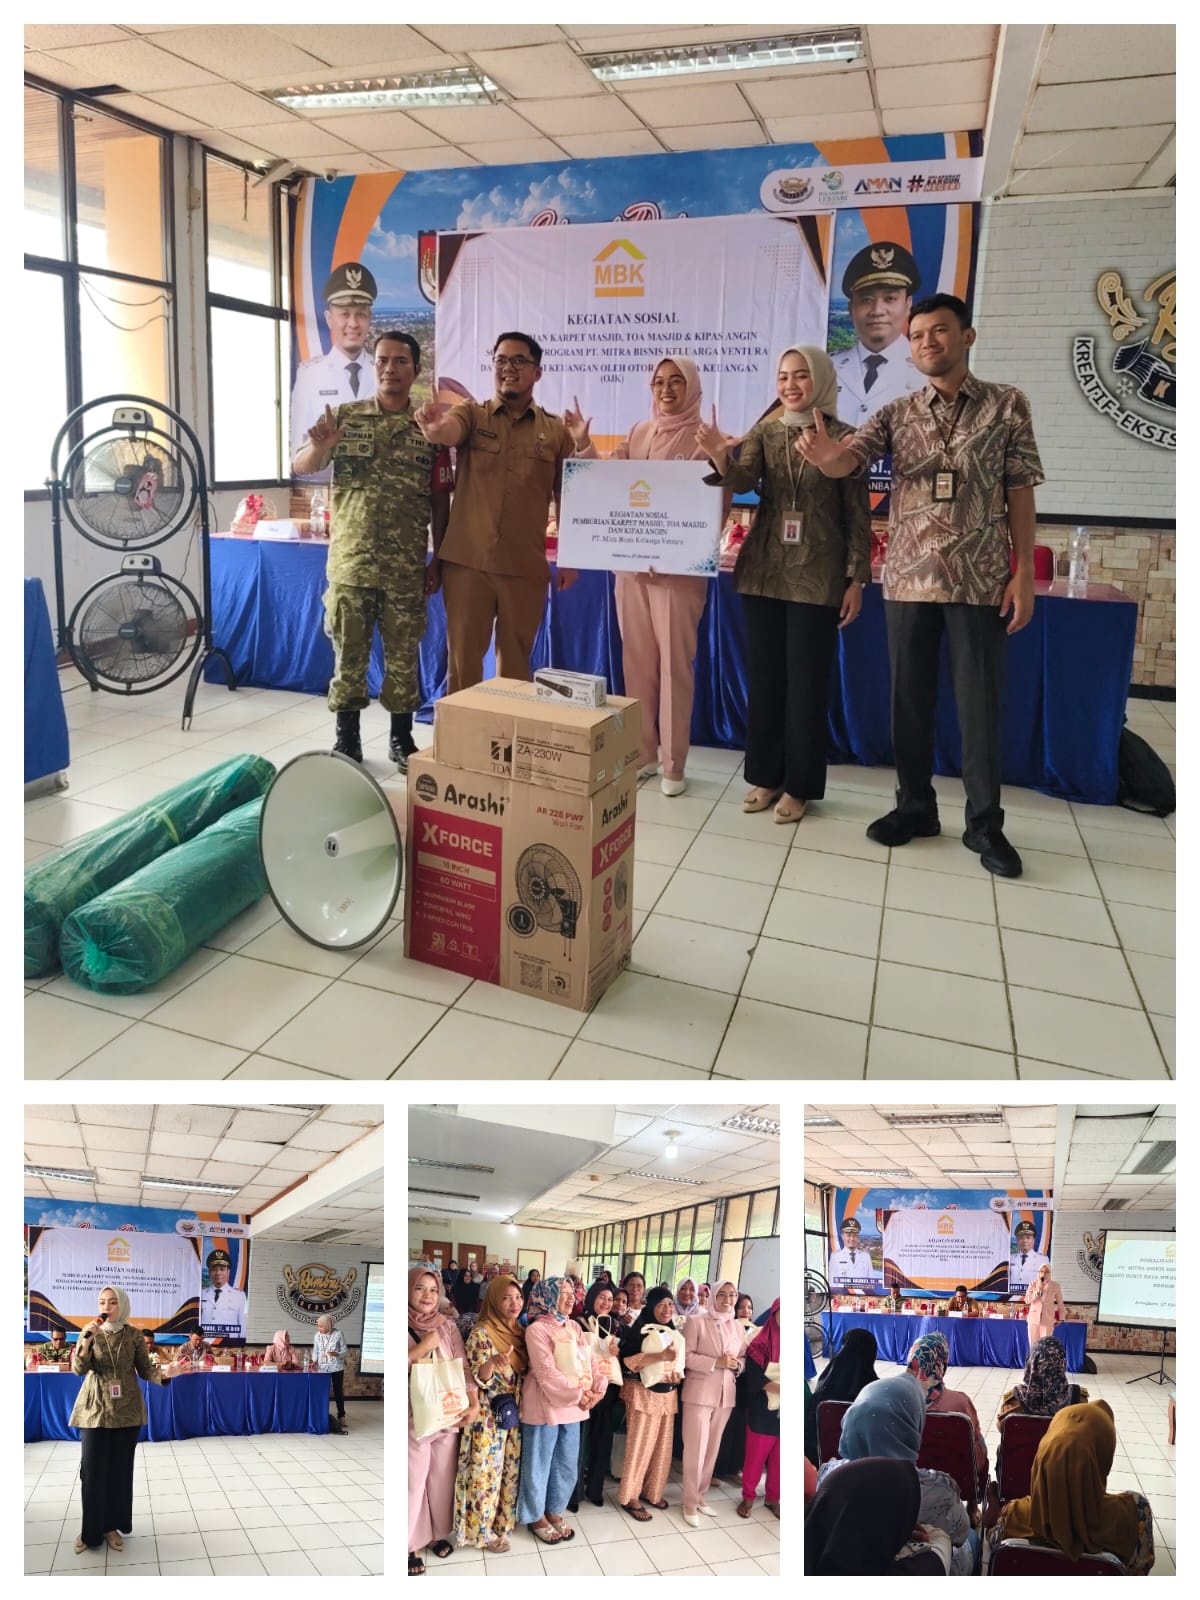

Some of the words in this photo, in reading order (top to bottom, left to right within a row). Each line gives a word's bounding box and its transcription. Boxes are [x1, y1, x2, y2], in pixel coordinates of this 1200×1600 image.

[855, 177, 902, 192] AMAN
[594, 264, 645, 285] MBK
[567, 313, 631, 325] KEGIATAN
[634, 312, 679, 325] SOSIAL
[550, 334, 587, 342] KARPET
[588, 333, 624, 343] MASJID,
[626, 333, 645, 342] TOA
[647, 332, 682, 341] MASJID
[684, 332, 692, 341] &
[694, 331, 723, 341] KIPAS
[723, 331, 758, 341] ANGIN
[601, 347, 631, 357] MITRA
[633, 347, 663, 357] BISNIS
[665, 346, 718, 356] KELUARGA
[720, 346, 768, 356] VENTURA
[549, 364, 598, 372] KEUANGAN
[600, 364, 625, 372] OLEH
[627, 363, 654, 373] OTOR
[703, 363, 758, 373] KEUANGAN
[600, 375, 624, 384] (OJK)
[410, 438, 425, 448] TNI
[645, 511, 669, 519] SOSIAL
[572, 517, 610, 526] PEMBERIAN
[610, 518, 637, 526] KARPET
[681, 521, 708, 529] MASJID
[624, 527, 644, 535] KIPAS
[645, 528, 667, 536] ANGIN
[516, 743, 562, 763] ZA-230W
[444, 783, 505, 817] Arashi
[536, 806, 547, 816] AR
[565, 812, 584, 823] PWF
[601, 792, 628, 828] Arashi
[551, 819, 569, 828] Wall
[569, 821, 584, 832] Fan
[451, 863, 470, 876] INCH
[450, 879, 472, 891] WATT
[457, 899, 476, 912] BLADE
[107, 1247, 130, 1257] MBK
